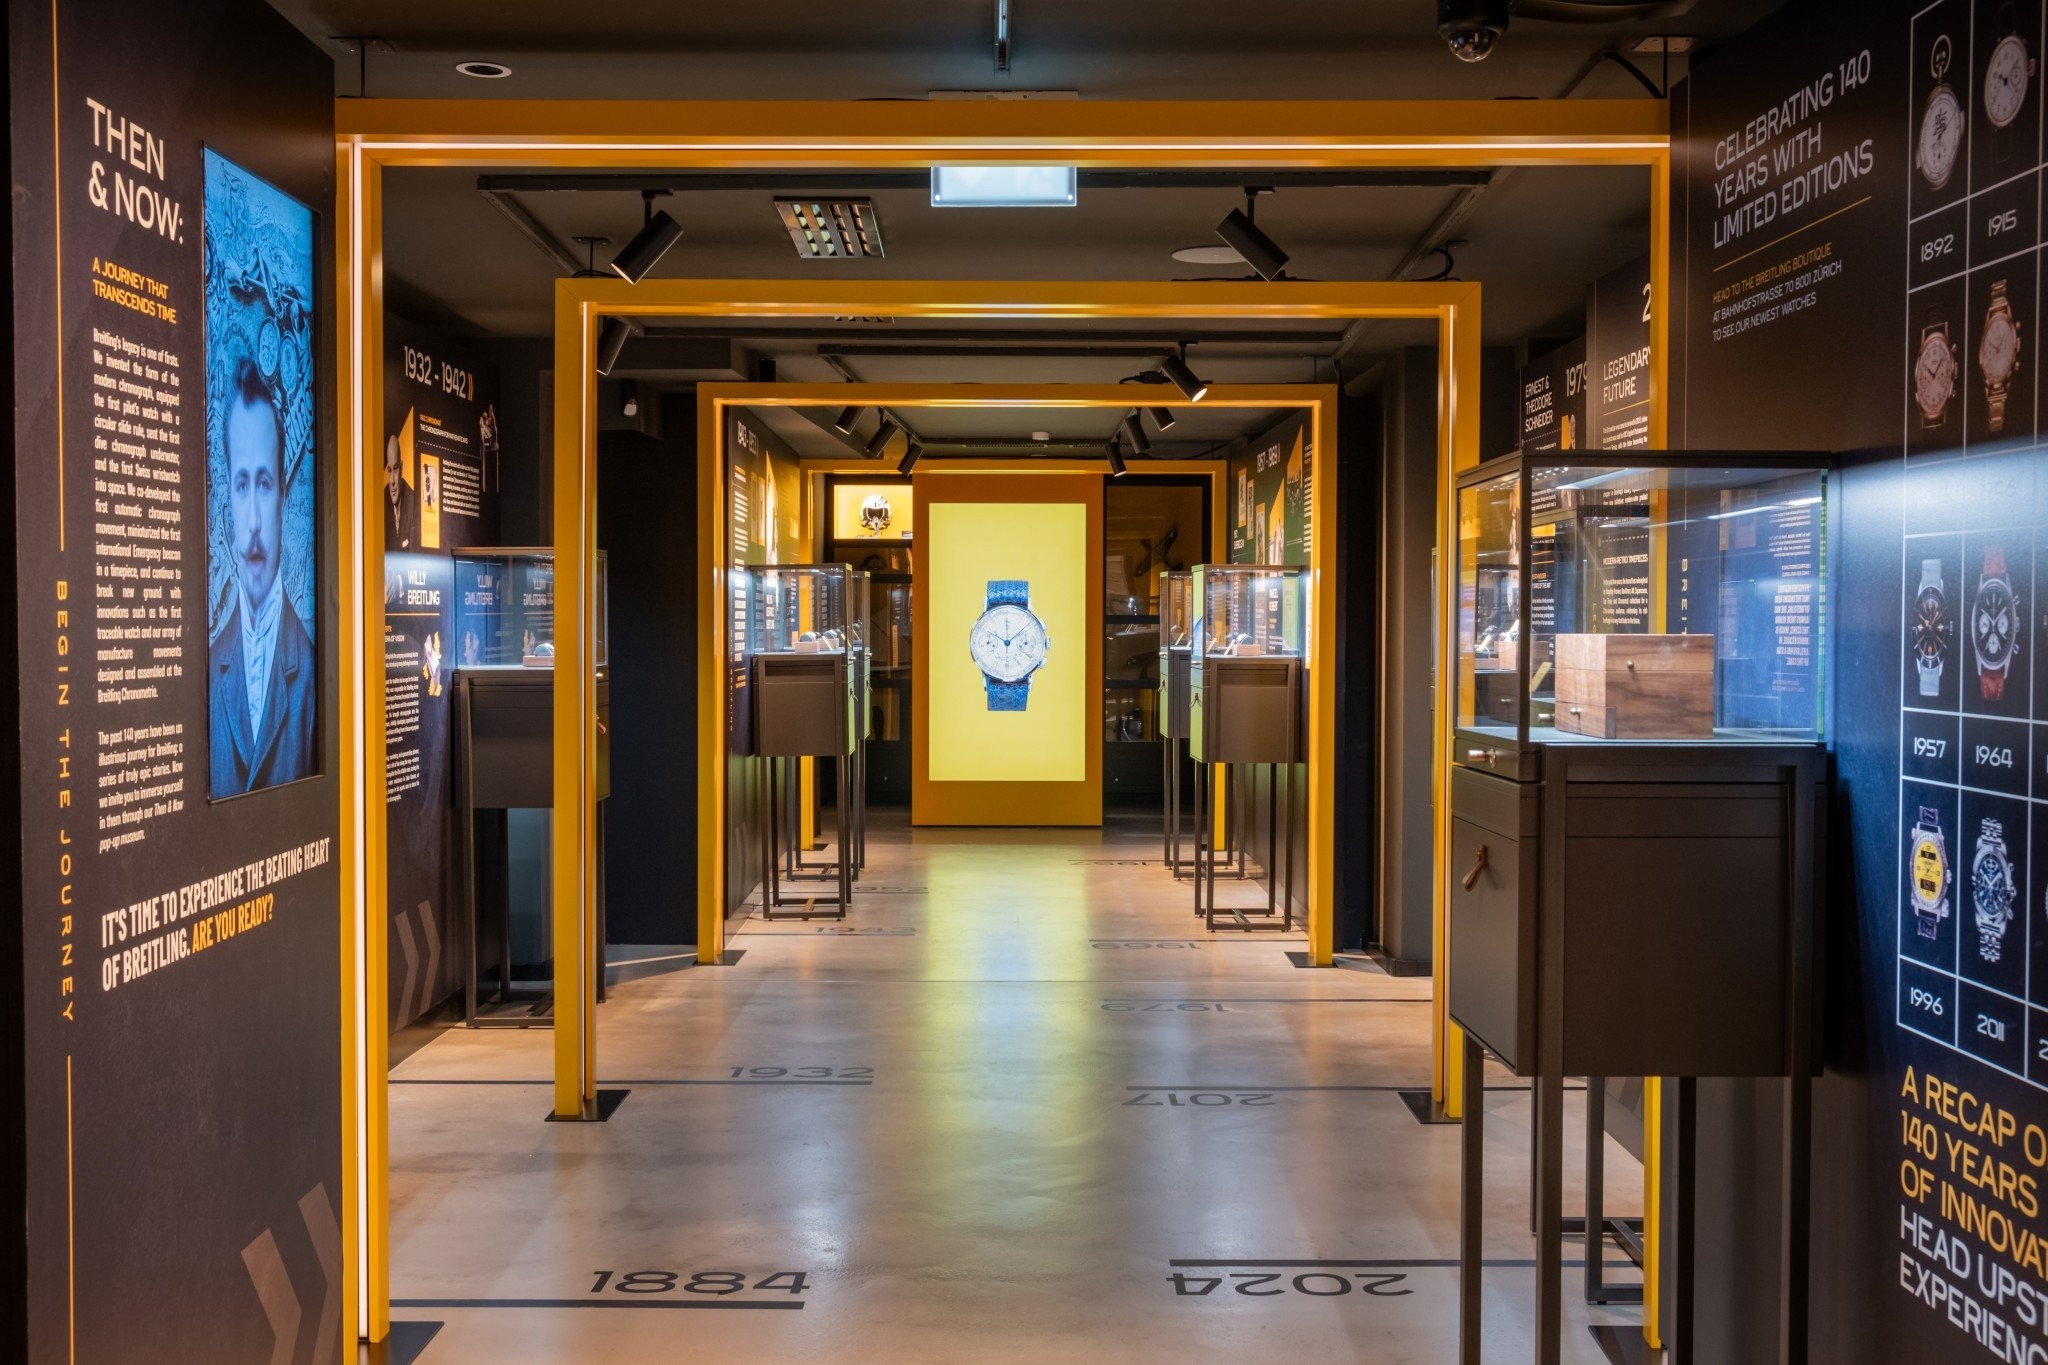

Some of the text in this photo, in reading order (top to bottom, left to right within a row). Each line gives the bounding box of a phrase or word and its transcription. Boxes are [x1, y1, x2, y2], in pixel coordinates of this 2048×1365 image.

[1714, 49, 1871, 171] CELEBRATING 140
[86, 96, 165, 182] THEN
[1714, 121, 1822, 209] YEARS WITH
[88, 160, 109, 211] &
[115, 171, 184, 245] NOW:
[1713, 138, 1874, 249] LIMITED EDITIONS
[1988, 209, 2018, 238] 1915
[1920, 234, 1955, 263] 1892
[92, 256, 169, 300] A JOURNEY THAT
[1712, 241, 1833, 304] HEAD TO THE BREITLING BOUTIQUE
[92, 279, 177, 325] TRANSCENDS TIME
[1712, 309, 1721, 324] AT
[1721, 283, 1784, 320] BAHNHOFSTRASSE
[1785, 279, 1795, 295] 70
[1812, 259, 1842, 283] ZÜRICH
[1712, 291, 1817, 342] TO SEE OUR NEWEST WATCHES
[404, 345, 432, 386] 1932
[441, 361, 467, 400] 1942
[1525, 377, 1545, 399] ERNEST
[1603, 376, 1637, 405] FUTURE
[1525, 391, 1553, 415] THEODORE
[1525, 409, 1554, 433] SCHNEIDER
[407, 569, 427, 586] WILLY
[407, 588, 440, 606] BREITLING
[1913, 736, 1947, 759] 1957
[1975, 744, 2014, 769] 1964
[56, 580, 74, 1022] BEGIN THE JOURNEY
[101, 836, 330, 949] IT'S TIME TO EXPERIENCE THE BEATING HEART
[101, 892, 274, 992] OF BREITLING. ARE YOU READY?
[1091, 942, 1201, 950] 1969
[1101, 1002, 1230, 1012] 1979
[1909, 986, 1945, 1017] 1996
[1976, 1013, 2006, 1043] 2011
[729, 1066, 875, 1079] 1932
[1120, 1092, 1278, 1107] 2017
[1901, 1064, 1920, 1105] A
[1925, 1073, 2017, 1148] RECAP
[1900, 1109, 2039, 1219] 140 YEARS
[1900, 1158, 1935, 1205] OF
[1900, 1203, 1971, 1281] HEAD
[590, 1270, 811, 1295] 1884
[1165, 1272, 1415, 1297] 2024
